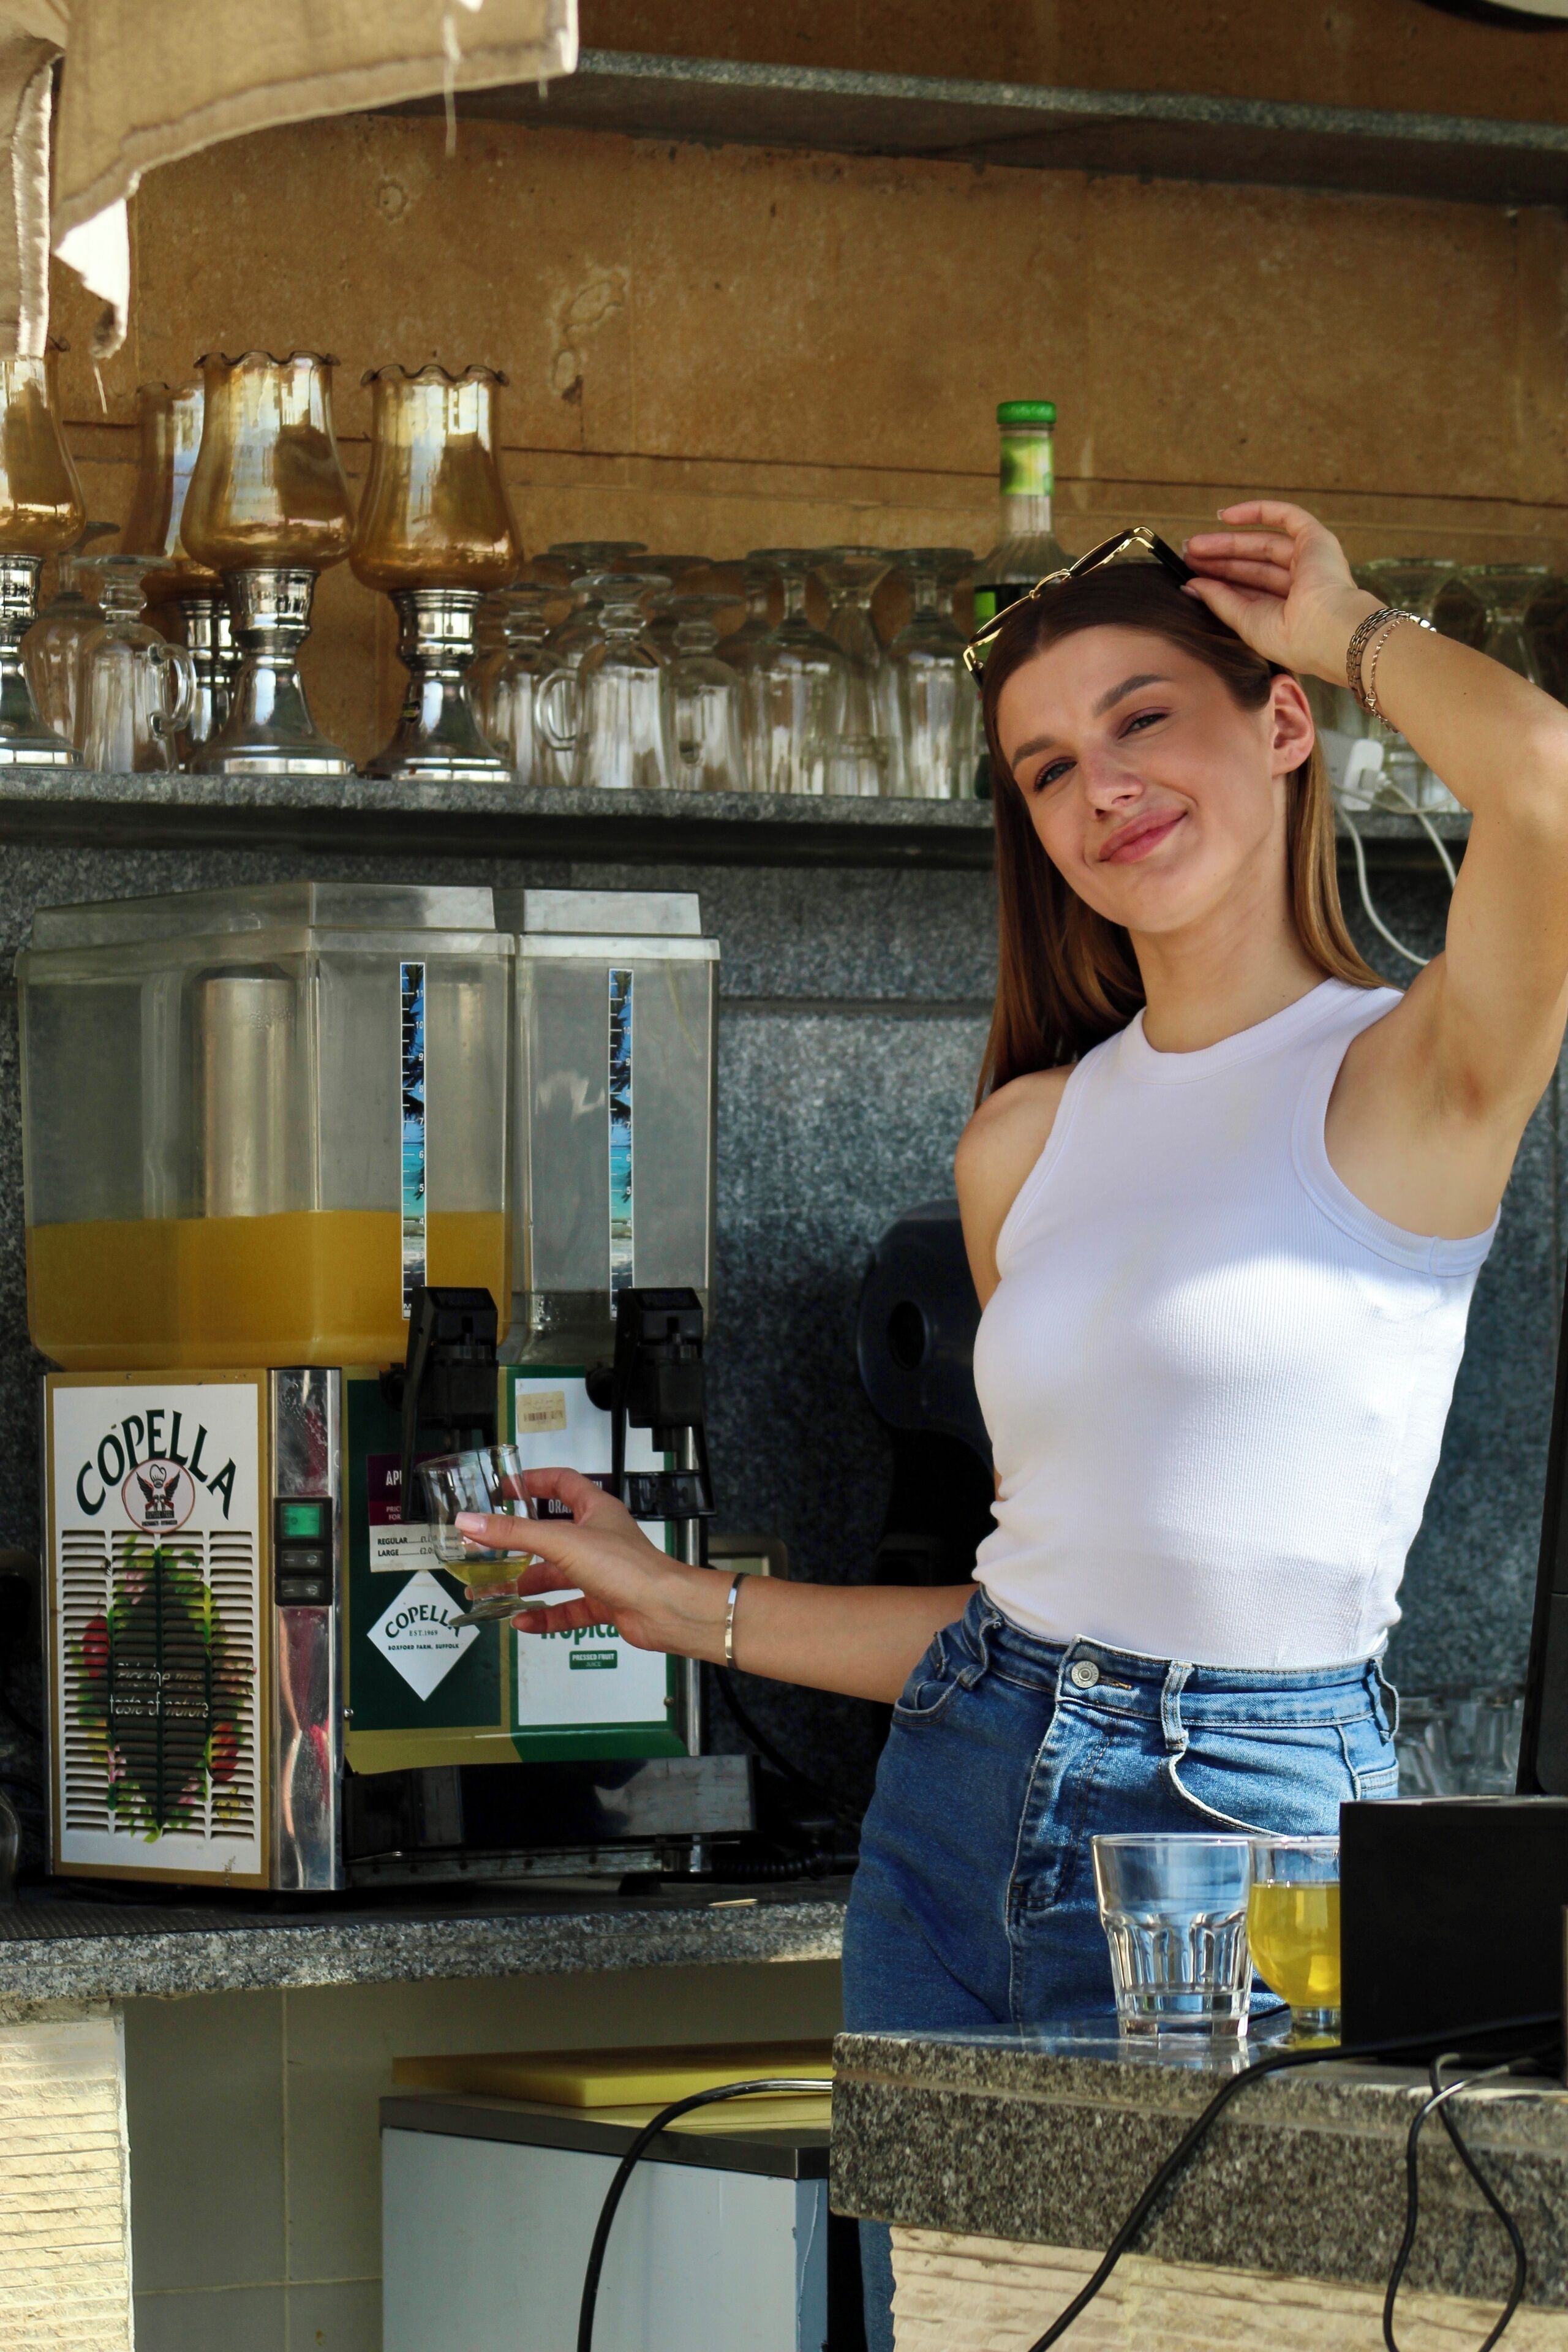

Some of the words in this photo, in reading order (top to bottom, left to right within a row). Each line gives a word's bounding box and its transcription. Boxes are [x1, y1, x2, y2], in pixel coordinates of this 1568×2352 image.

[76, 1408, 236, 1520] COPELLA
[386, 1470, 402, 1486] AP
[548, 1499, 572, 1514] ORA
